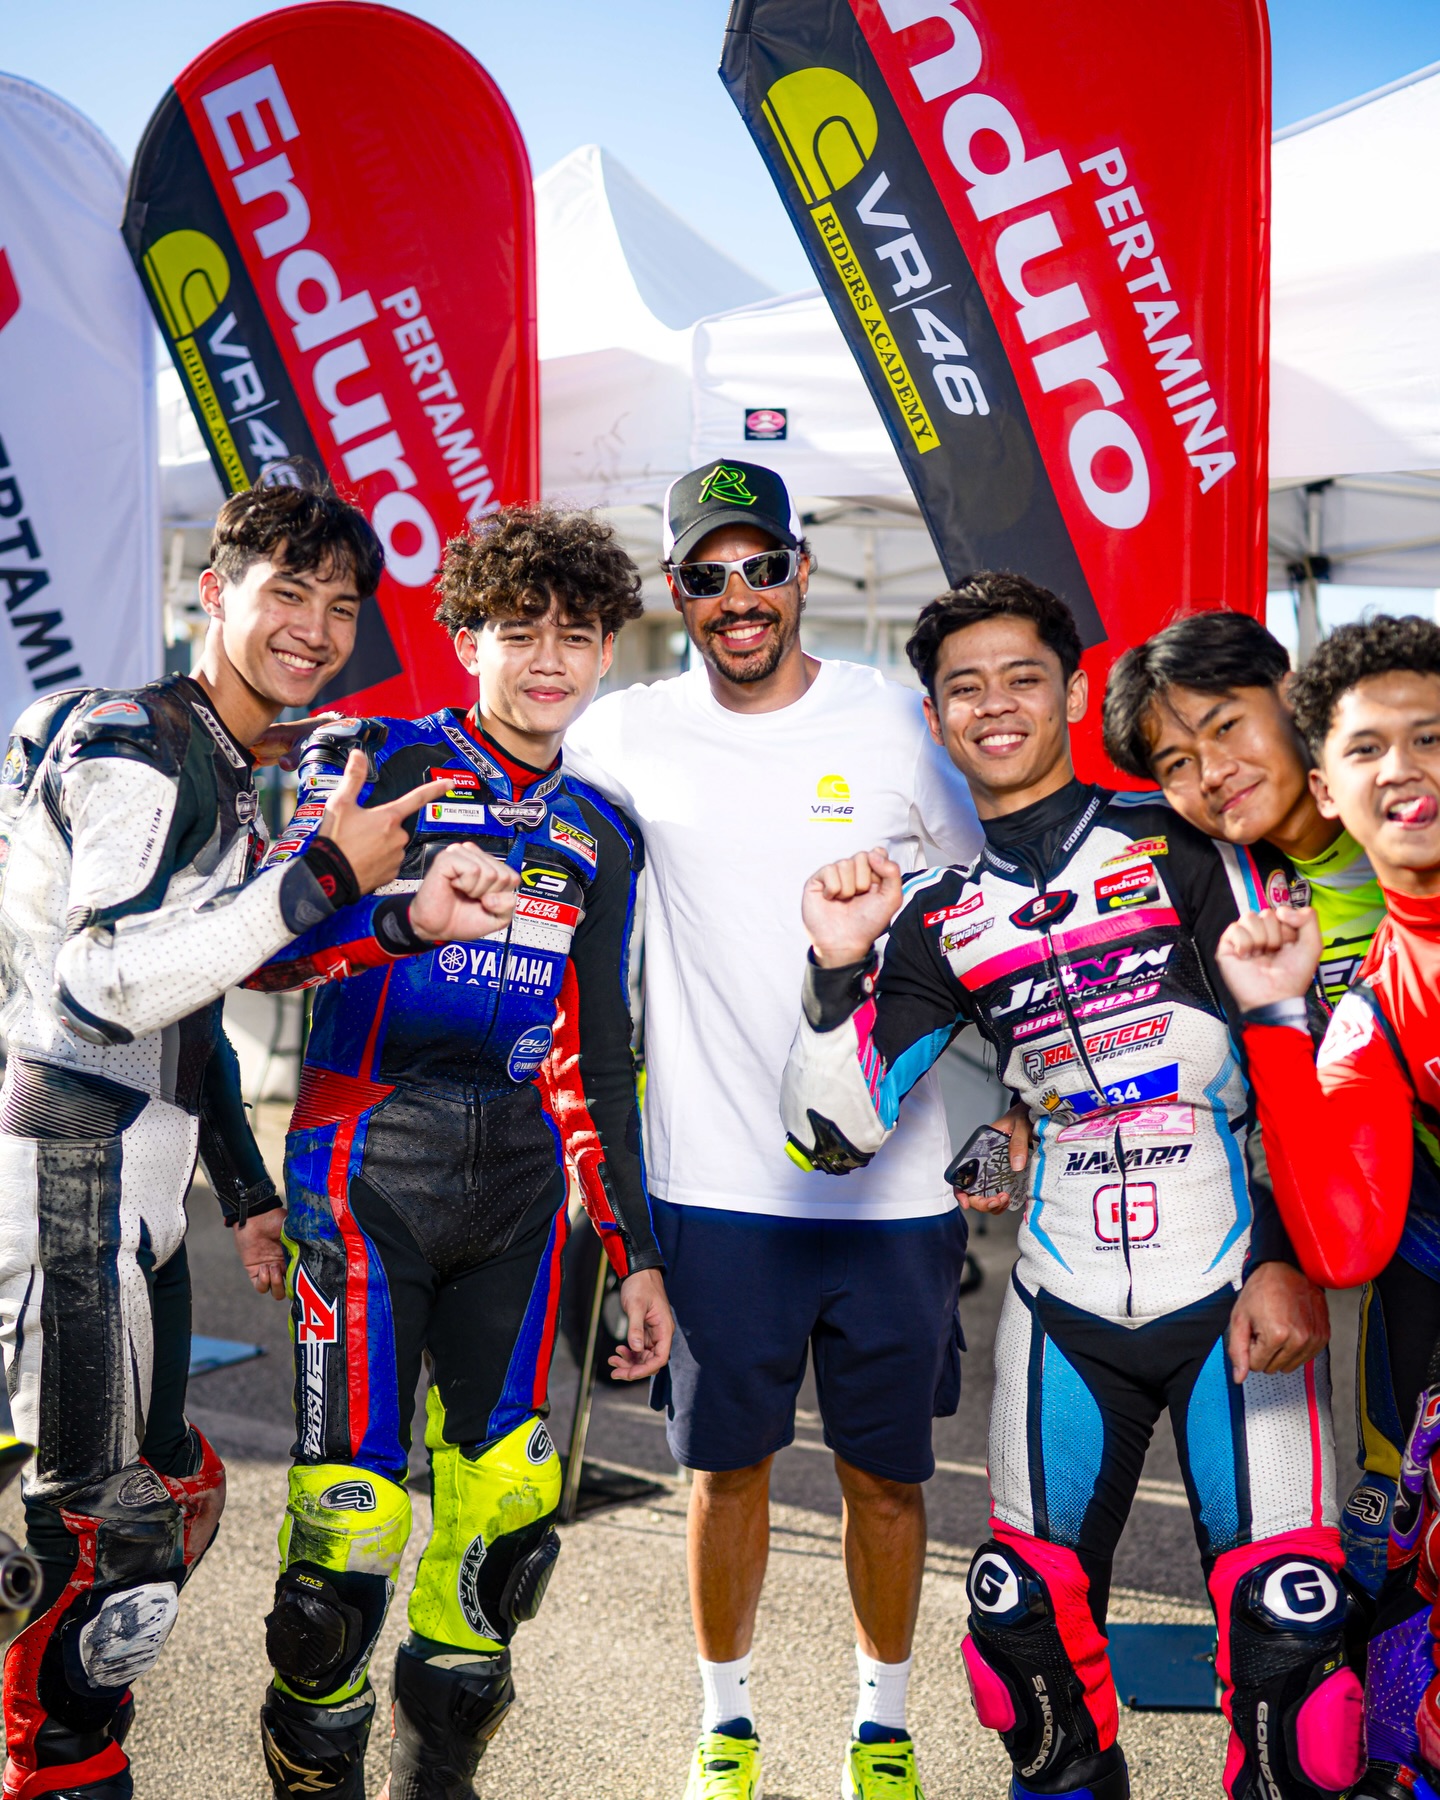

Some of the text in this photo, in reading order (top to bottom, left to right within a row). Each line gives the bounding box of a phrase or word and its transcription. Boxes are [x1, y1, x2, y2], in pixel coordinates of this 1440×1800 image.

[200, 63, 442, 588] Enduro
[817, 210, 935, 442] RIDERS ACADEMY
[1079, 147, 1237, 494] PERTAMINA
[182, 346, 220, 421] RIDERS
[526, 908, 559, 920] RACING
[1100, 875, 1151, 896] Enduro
[446, 974, 545, 996] RACING
[470, 948, 553, 988] YAMAHA
